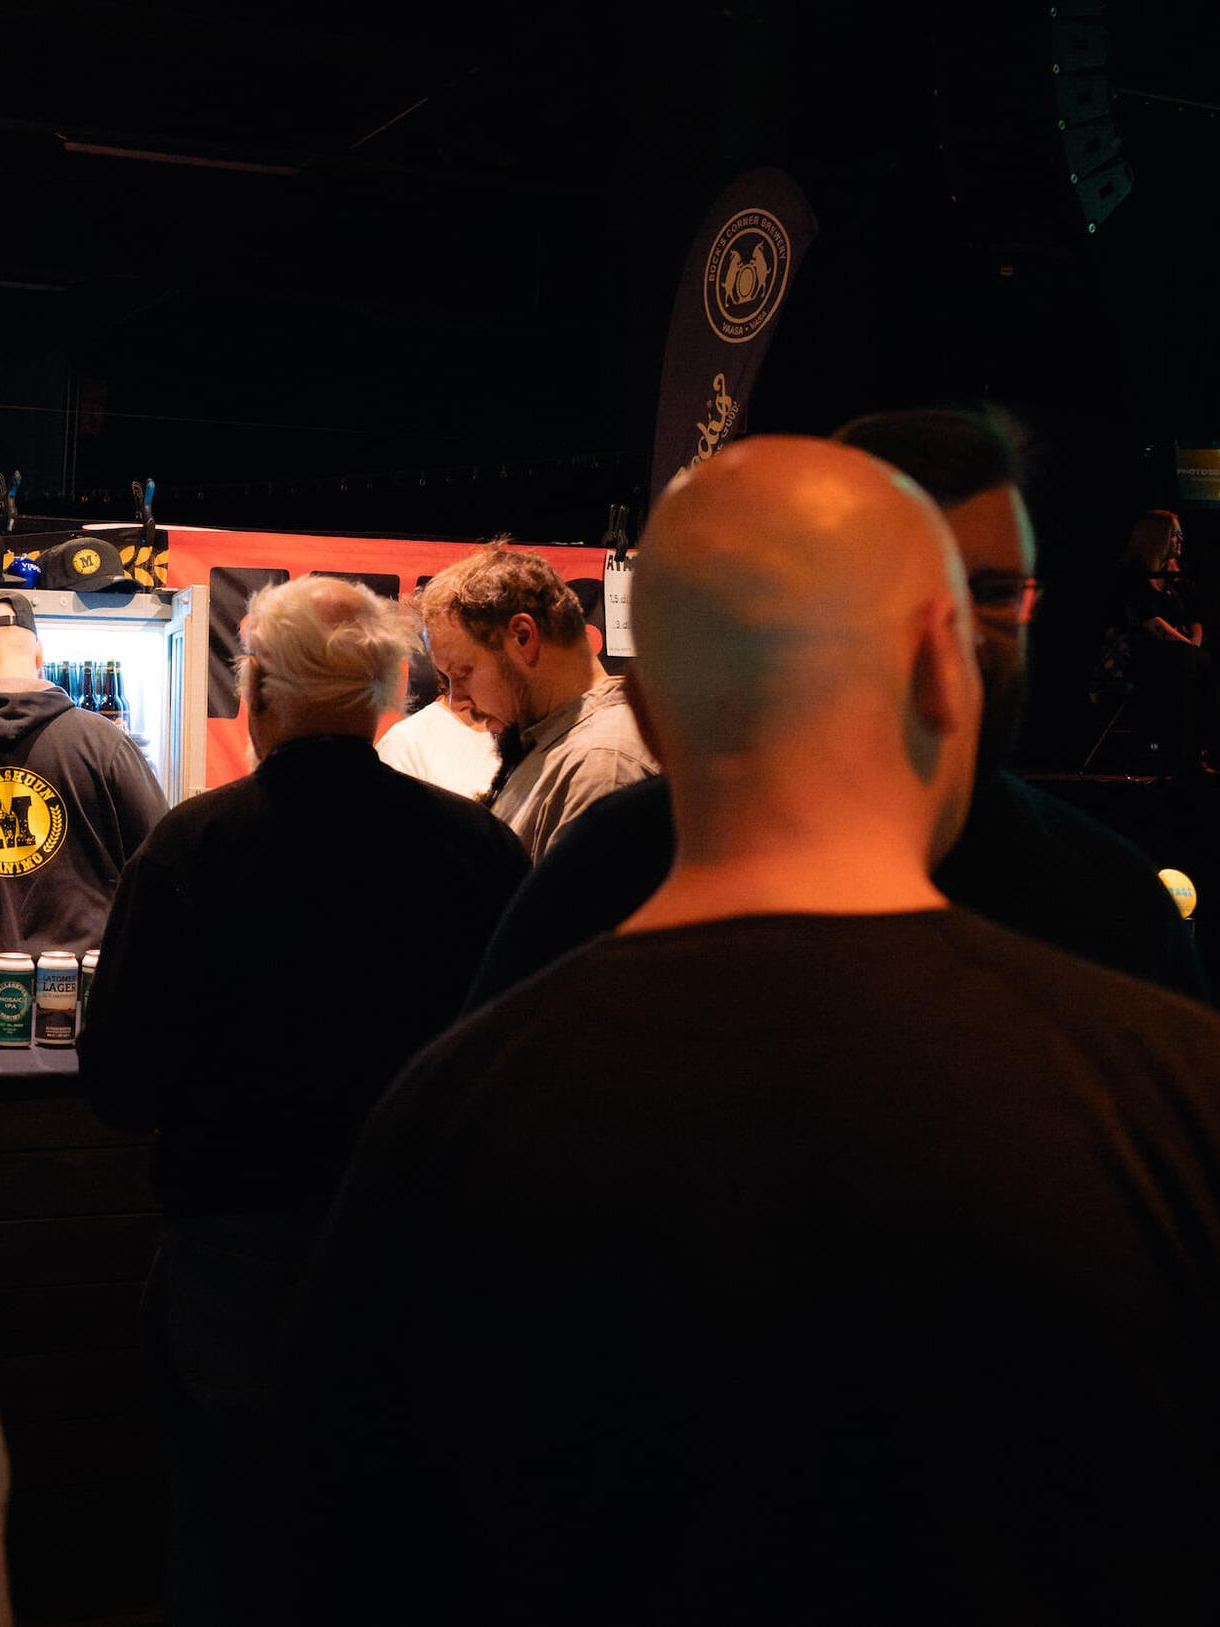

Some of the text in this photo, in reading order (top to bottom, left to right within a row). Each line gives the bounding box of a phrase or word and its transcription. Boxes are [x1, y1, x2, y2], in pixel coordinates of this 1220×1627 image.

[708, 216, 786, 283] BOCK'S CORNER BREWERY
[43, 982, 76, 993] LAGER
